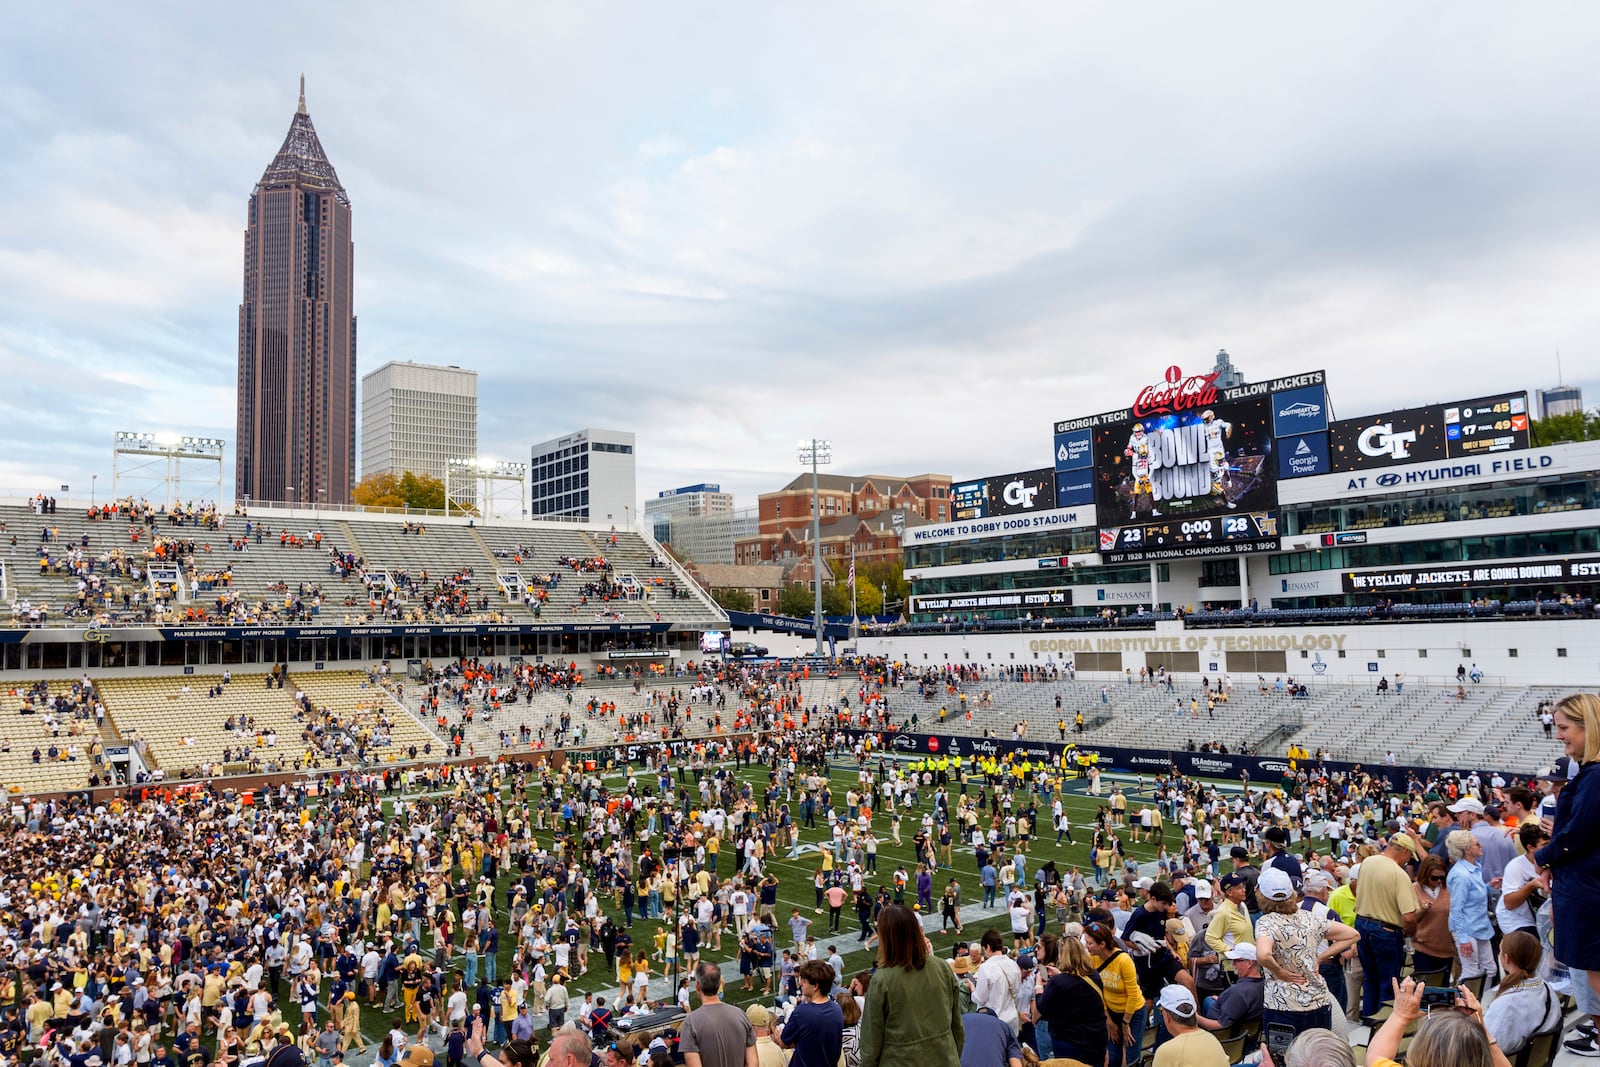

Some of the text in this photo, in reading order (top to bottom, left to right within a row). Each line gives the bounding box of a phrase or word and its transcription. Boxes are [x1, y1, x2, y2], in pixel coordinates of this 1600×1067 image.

[1224, 372, 1322, 399] YELLOW JACKETS
[1133, 370, 1222, 417] Coca-Cola
[1279, 407, 1311, 417] SOUTHEAST
[1493, 402, 1510, 413] 45
[1058, 410, 1128, 432] GEORGIA TECH
[1462, 424, 1476, 435] 17
[1494, 420, 1511, 430] 49
[1147, 423, 1210, 470] BOWL
[1358, 422, 1416, 459] GT
[1289, 455, 1318, 466] Georgia
[1292, 465, 1315, 473] Power
[1347, 456, 1552, 490] AT HYUNDAI FIELD
[1152, 462, 1211, 501] BOUND
[1003, 480, 1038, 508] GT
[914, 513, 1077, 539] WELCOME TO BOBBY DODD STADIUM
[1163, 526, 1169, 534] 6
[1181, 520, 1211, 534] 0:00
[1227, 518, 1248, 532] 28
[1124, 529, 1141, 542] 23
[1327, 534, 1333, 545] 0
[1111, 554, 1124, 562] 1917
[1127, 552, 1142, 560] 1928
[1146, 549, 1184, 559] NATIONAL
[1185, 545, 1230, 556] CHAMPIONS
[1235, 544, 1252, 552] 1952
[1062, 558, 1067, 566] 0
[1354, 576, 1366, 587] THE
[1367, 574, 1412, 586] YELLOW
[1473, 569, 1490, 581] ARE
[1490, 567, 1518, 580] GOING
[1519, 565, 1562, 578] BOWLING
[1287, 581, 1321, 592] RENASANT
[926, 600, 949, 608] YELLOW
[950, 598, 977, 607] JACKETS
[1106, 592, 1150, 600] RENASANT
[785, 621, 810, 629] HYUNDAI
[84, 629, 111, 643] GT
[1029, 634, 1347, 652] GEORGIA INSTITUTE OF TECHNOLOGY
[570, 935, 575, 943] 0
[4, 1039, 16, 1051] 27
